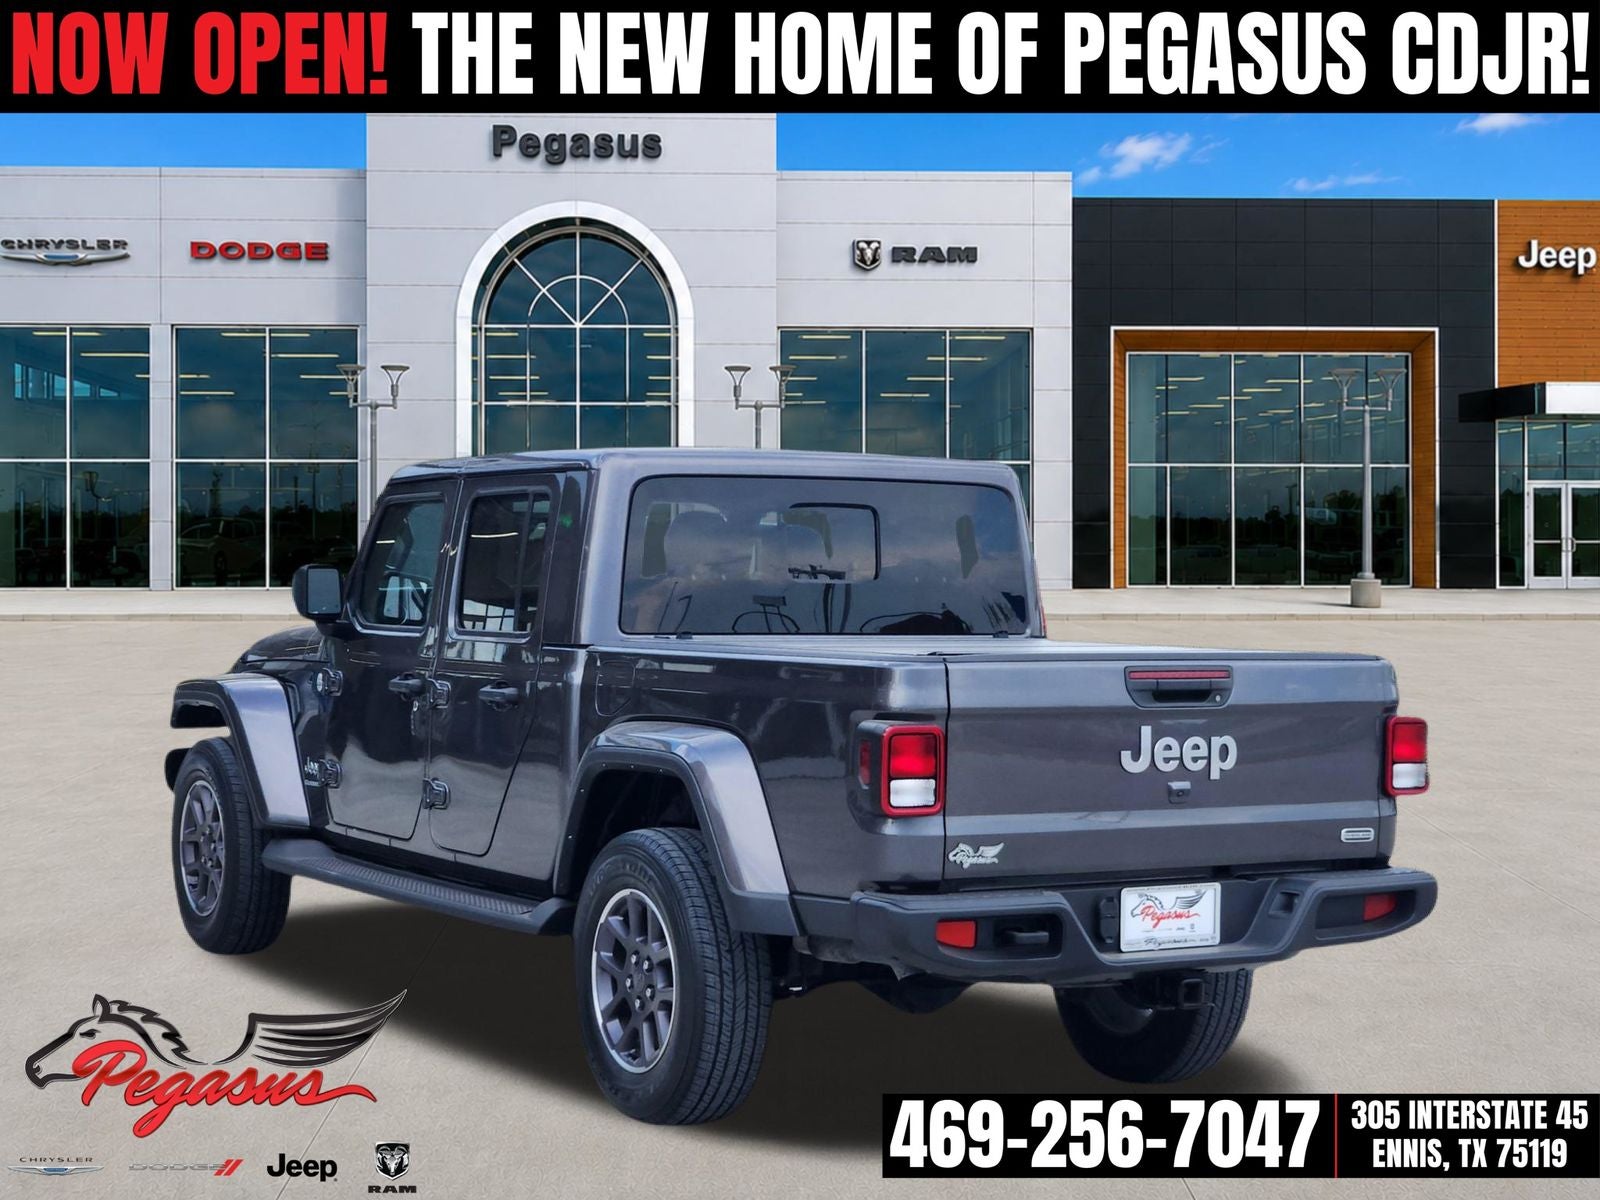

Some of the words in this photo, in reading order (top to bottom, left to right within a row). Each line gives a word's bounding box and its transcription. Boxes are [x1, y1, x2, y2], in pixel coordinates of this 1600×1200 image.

[492, 125, 662, 166] Pegasus
[1, 239, 129, 250] CHRYSLER
[190, 241, 329, 260] DODGE
[891, 246, 978, 263] RAM
[1518, 239, 1597, 275] Jeep
[1121, 725, 1238, 780] Jeep
[1141, 905, 1200, 928] Pegasus
